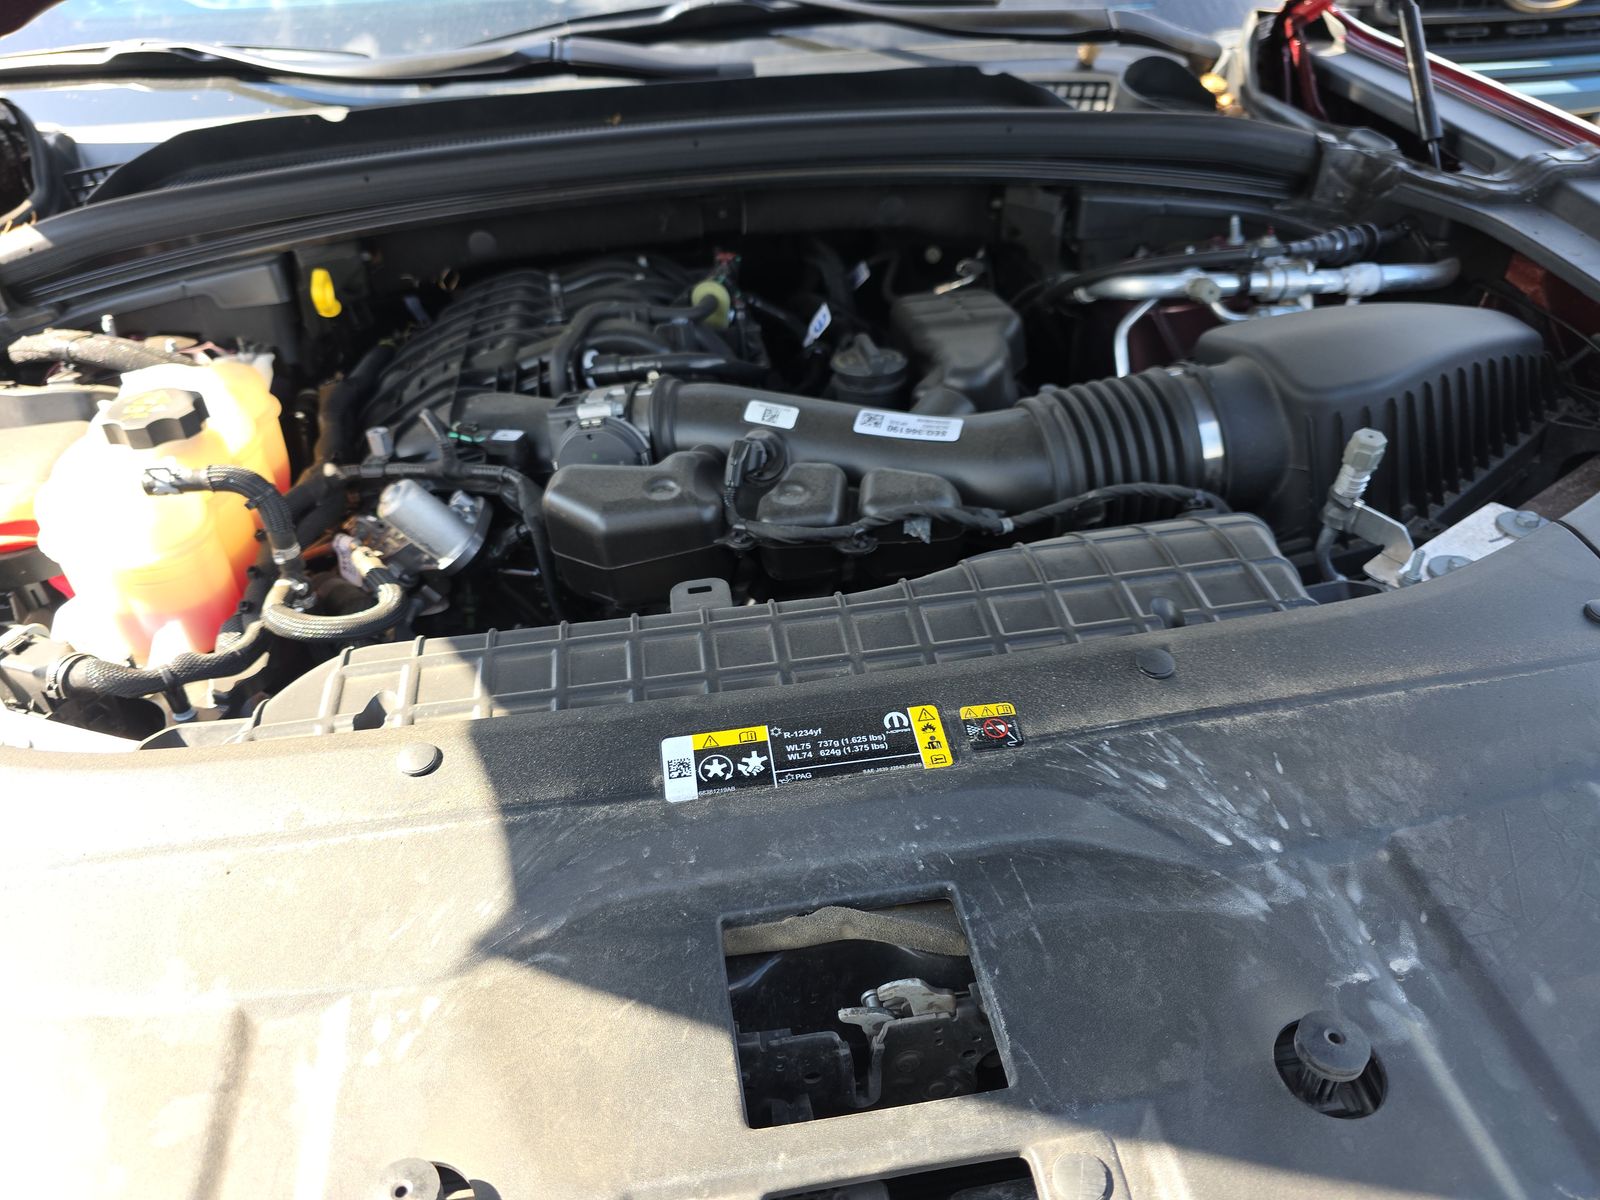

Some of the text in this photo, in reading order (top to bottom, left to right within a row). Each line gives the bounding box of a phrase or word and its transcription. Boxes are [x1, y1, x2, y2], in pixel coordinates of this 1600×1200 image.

[784, 728, 822, 739] R-1234yf
[786, 733, 886, 752] WL75 737g (1.625 lbs)
[787, 742, 889, 761] WL74 624g (1.375 lbs)
[795, 772, 812, 780] PAG
